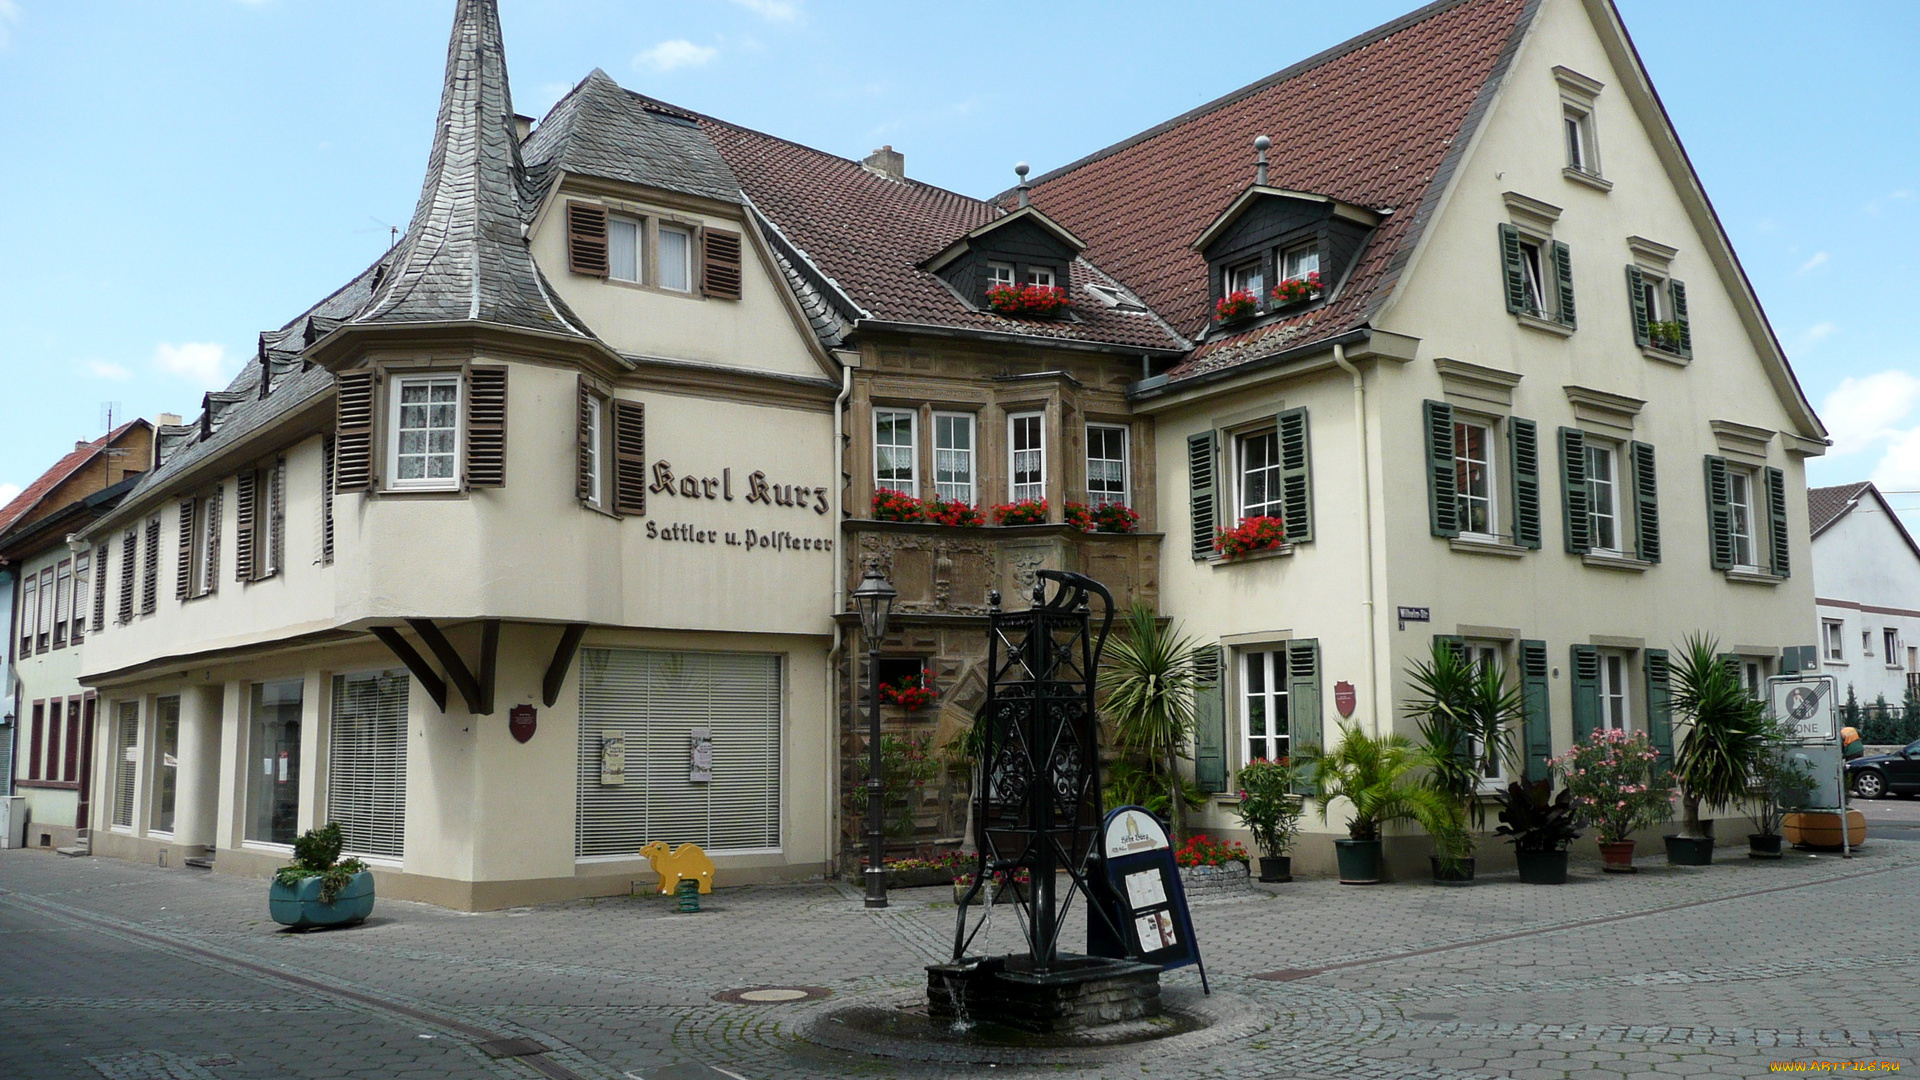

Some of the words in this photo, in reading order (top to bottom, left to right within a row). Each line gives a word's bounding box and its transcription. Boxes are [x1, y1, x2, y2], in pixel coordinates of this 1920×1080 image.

[649, 459, 735, 501] Karl
[745, 469, 830, 515] Kurz
[646, 519, 718, 544] Sattler
[725, 531, 742, 546] u.
